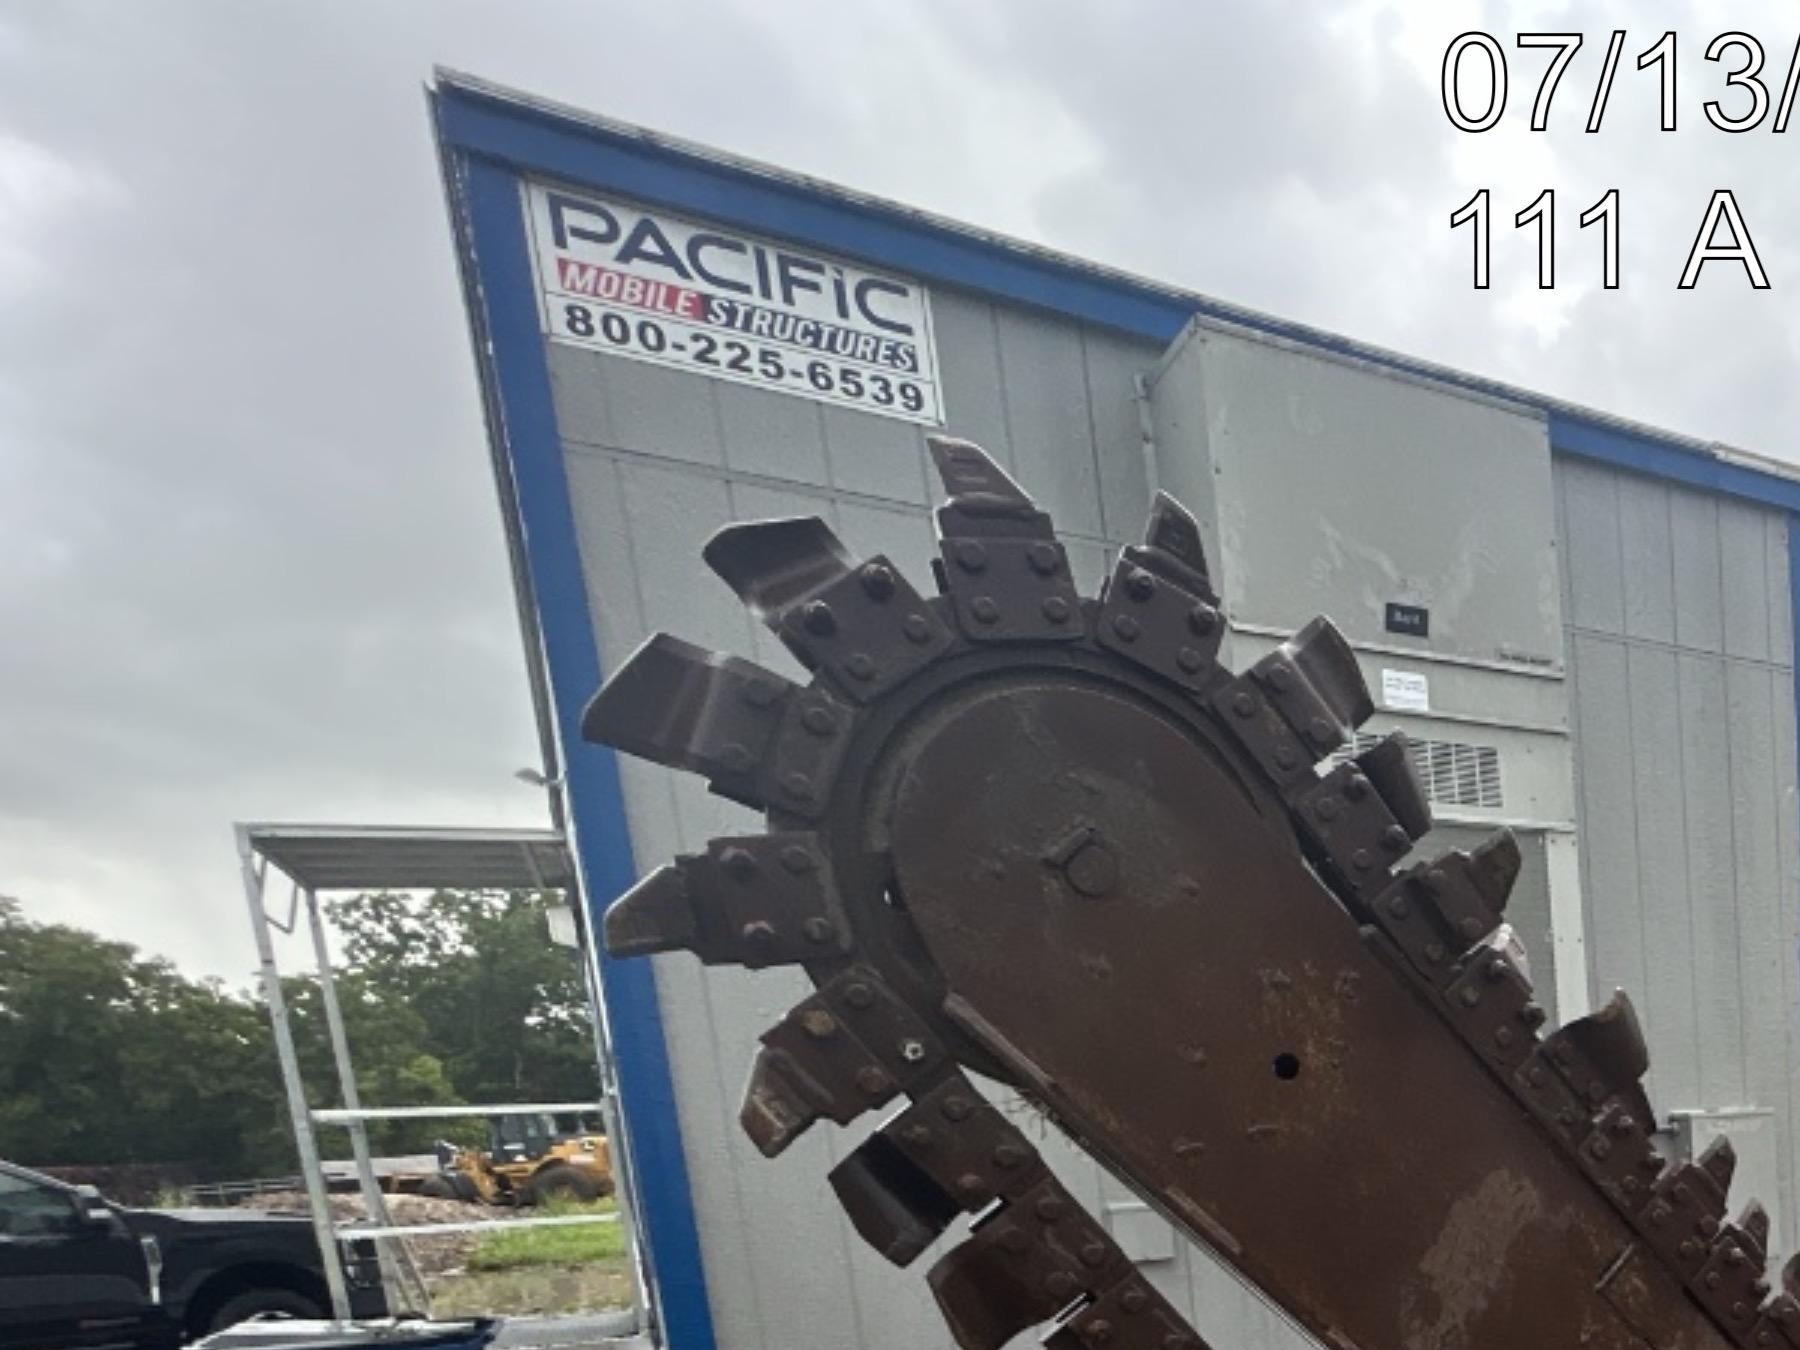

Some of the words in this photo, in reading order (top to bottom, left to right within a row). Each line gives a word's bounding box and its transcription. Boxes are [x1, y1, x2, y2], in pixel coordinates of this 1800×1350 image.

[562, 262, 697, 317] MOBILE
[706, 298, 916, 373] STRUCTURES
[564, 303, 925, 412] 800-225-6539
